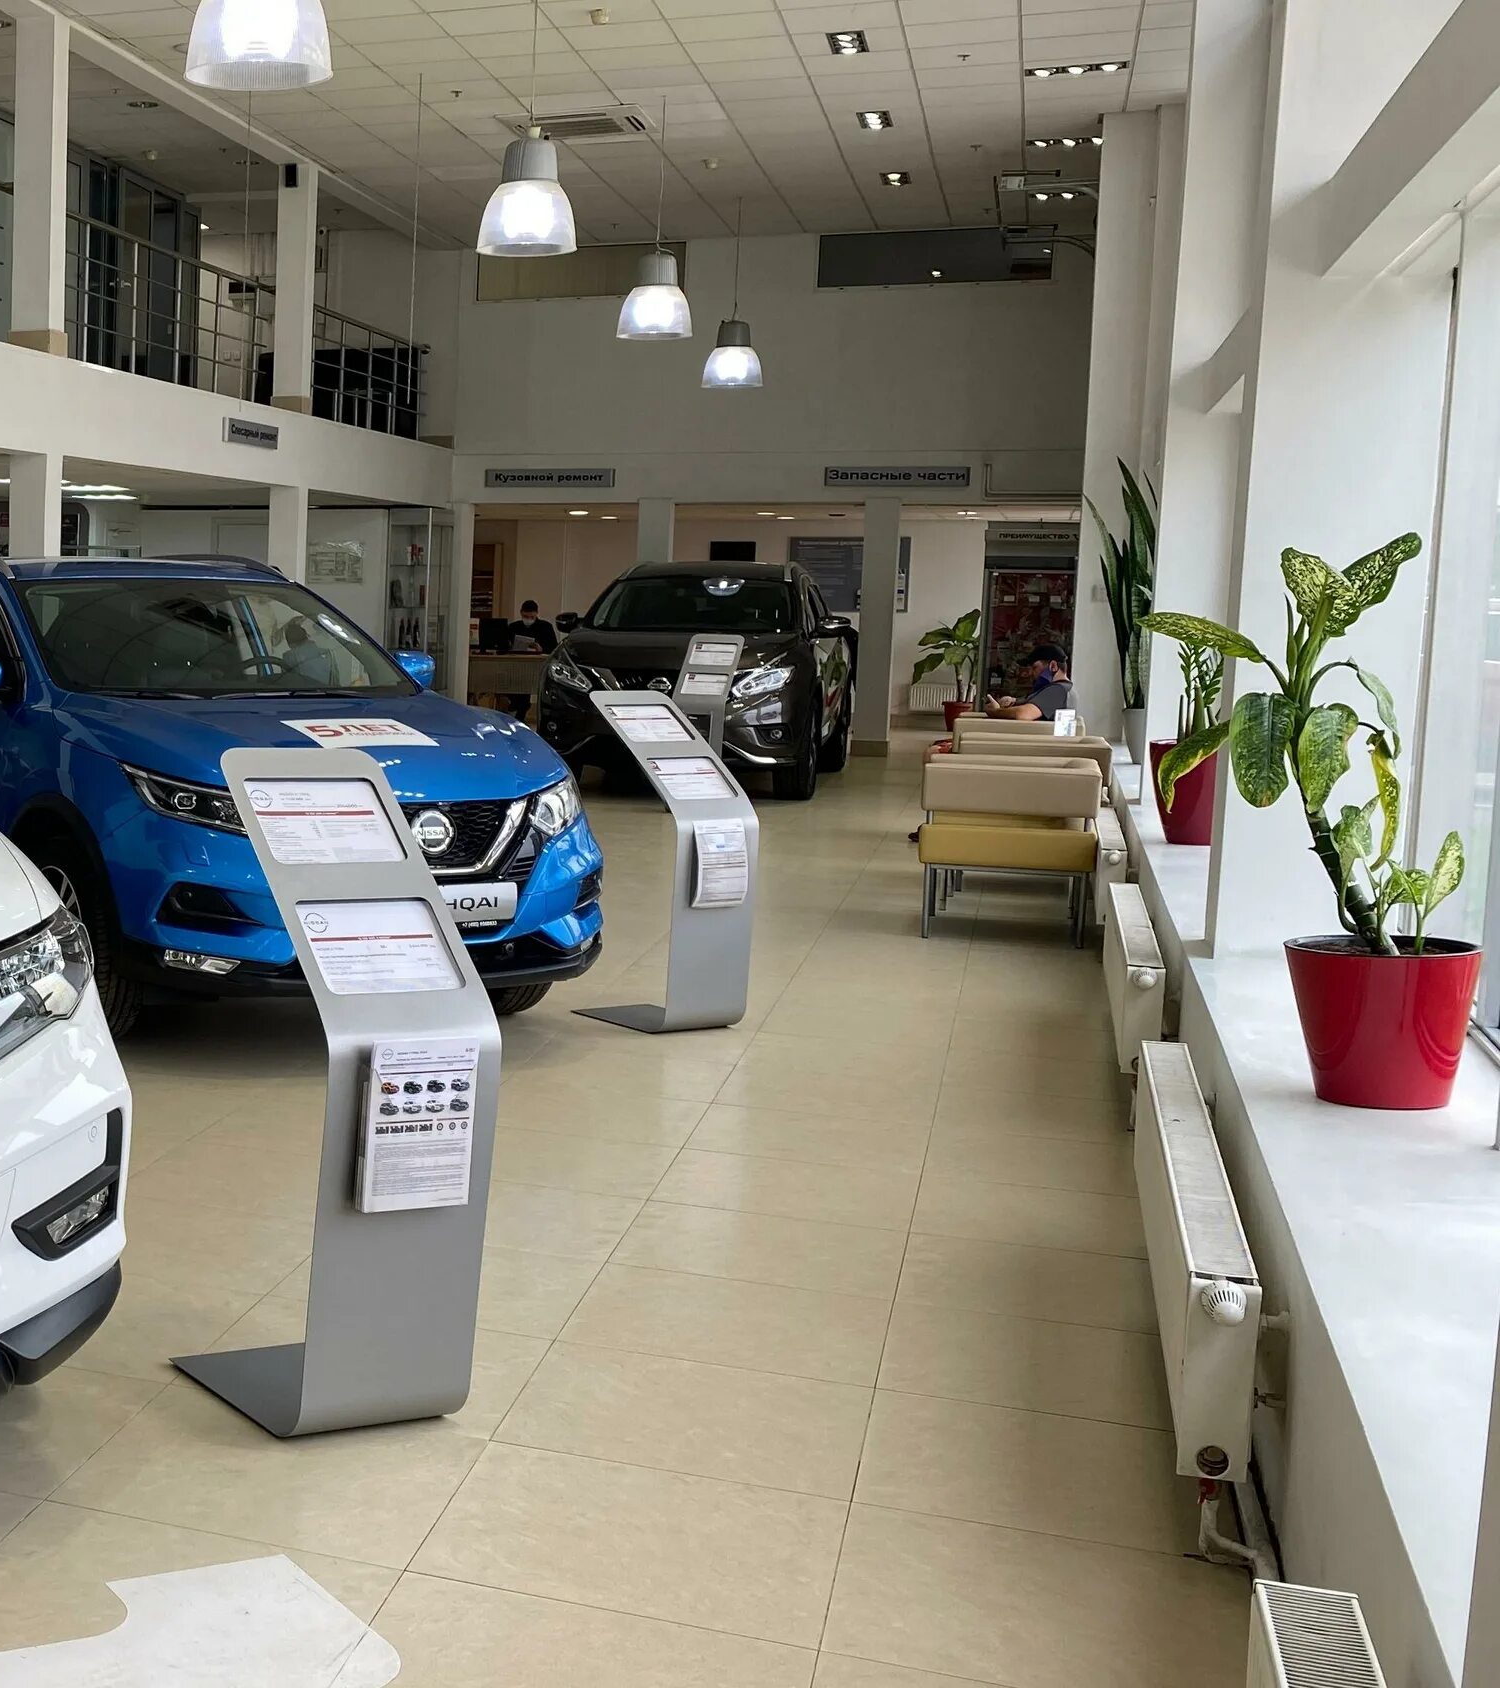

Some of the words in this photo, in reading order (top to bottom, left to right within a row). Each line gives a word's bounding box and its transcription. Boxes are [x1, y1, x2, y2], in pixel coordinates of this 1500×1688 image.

[494, 472, 554, 483] Кузовной
[559, 474, 604, 483] ремонт
[828, 469, 912, 481] Запасные
[917, 472, 966, 481] части
[998, 532, 1070, 540] ПРЕИМУЩЕСТВО
[304, 725, 344, 738] 5
[340, 724, 401, 732] ЛЕТ
[416, 829, 450, 837] NISSA
[446, 896, 499, 912] HQAI
